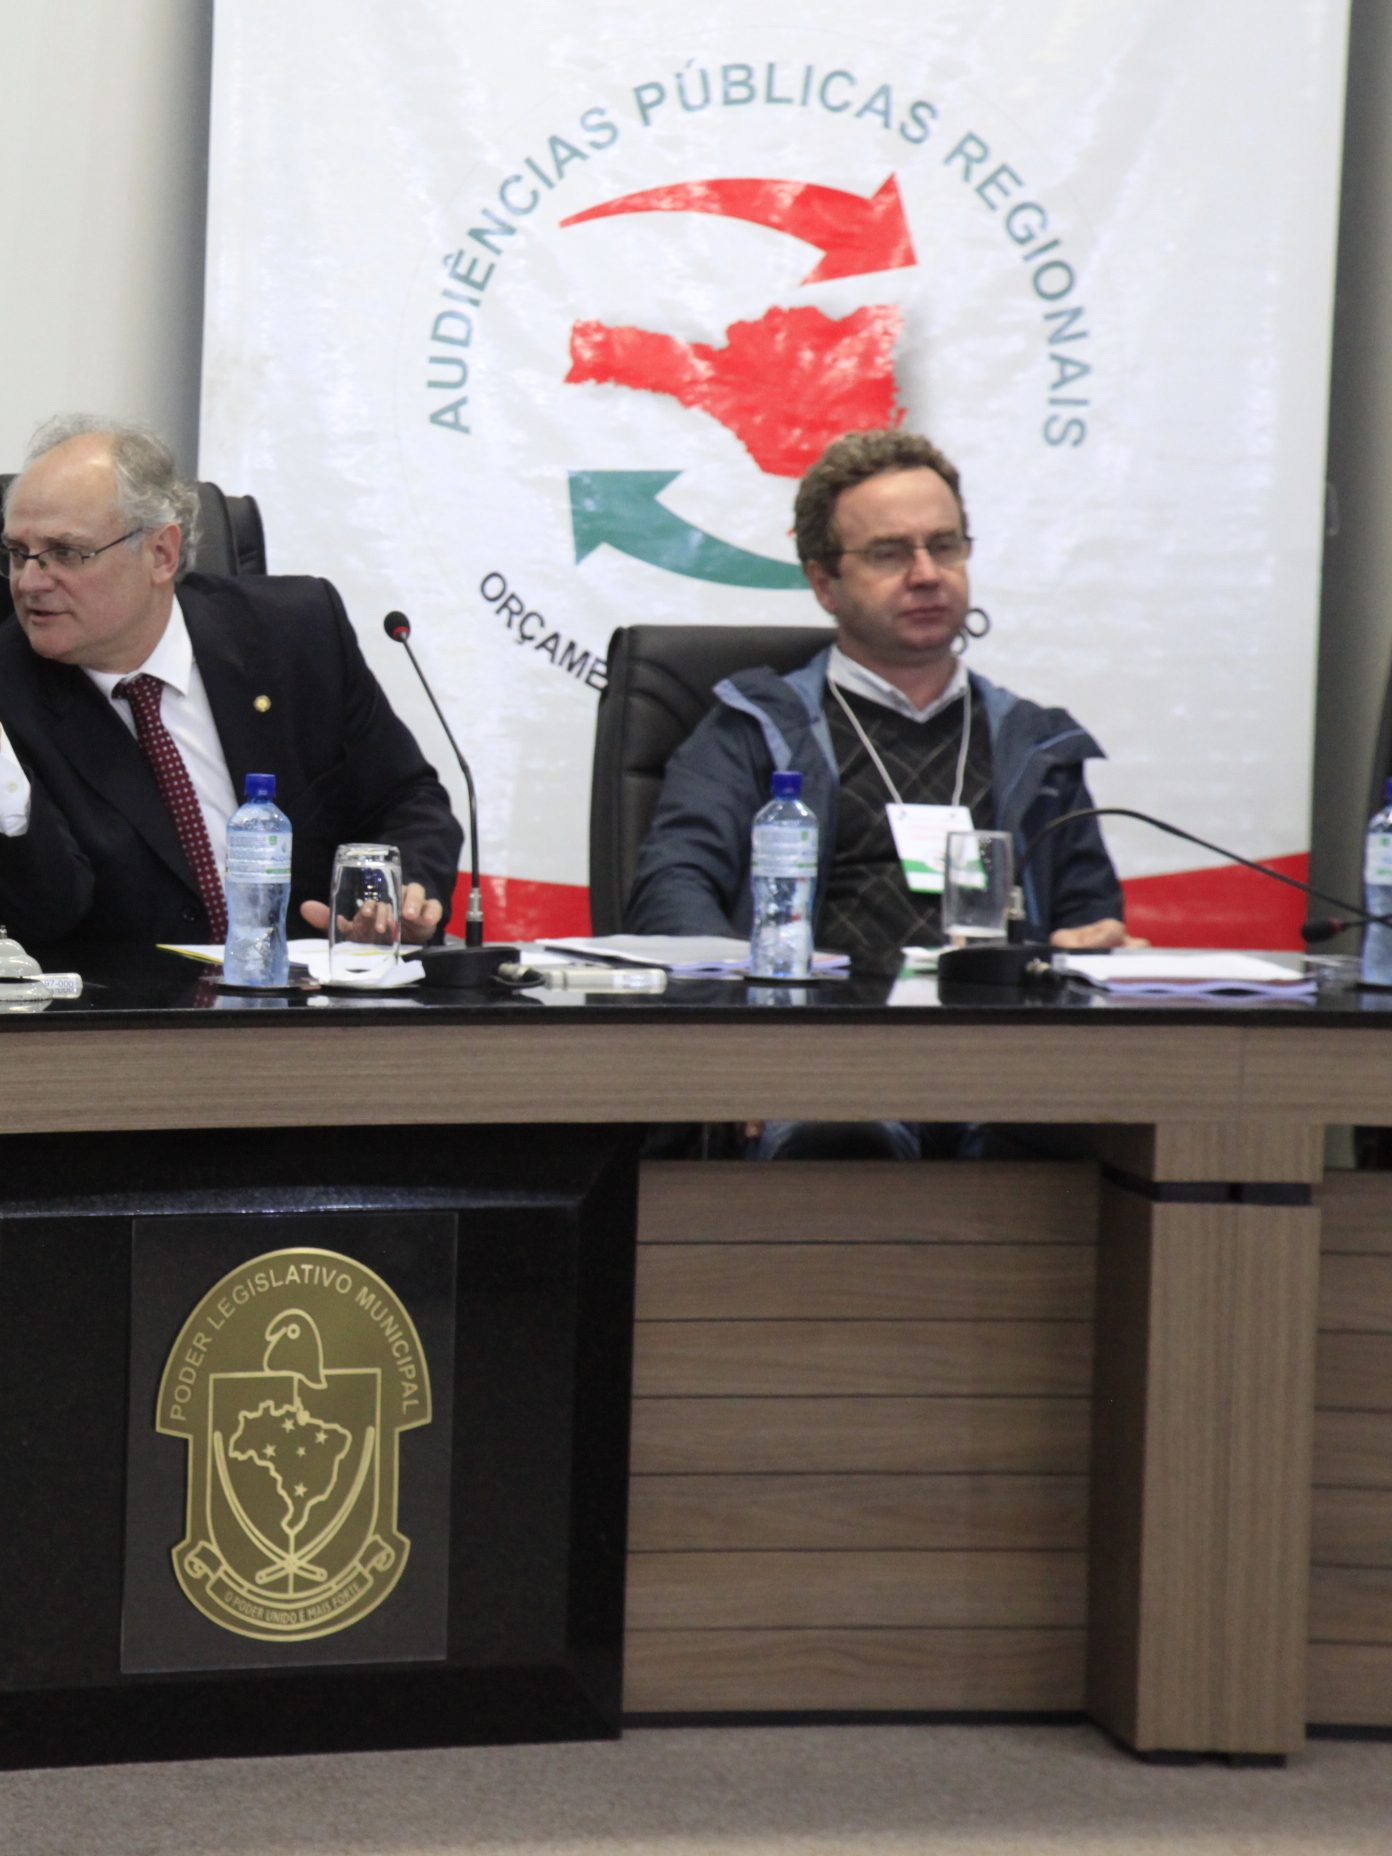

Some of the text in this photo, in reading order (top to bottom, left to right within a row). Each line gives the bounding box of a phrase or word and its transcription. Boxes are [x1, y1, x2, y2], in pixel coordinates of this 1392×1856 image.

[426, 59, 1093, 449] AUDIÊNCIAS PÚBLICAS REGIONAIS
[480, 571, 608, 692] ORÇAME
[170, 1264, 420, 1421] PODER LEGISLATIVO MUNICIPAL
[232, 1595, 263, 1620] PODER
[266, 1610, 298, 1624] UNIDO
[307, 1602, 331, 1621] MAIS
[331, 1581, 363, 1610] FORTE
